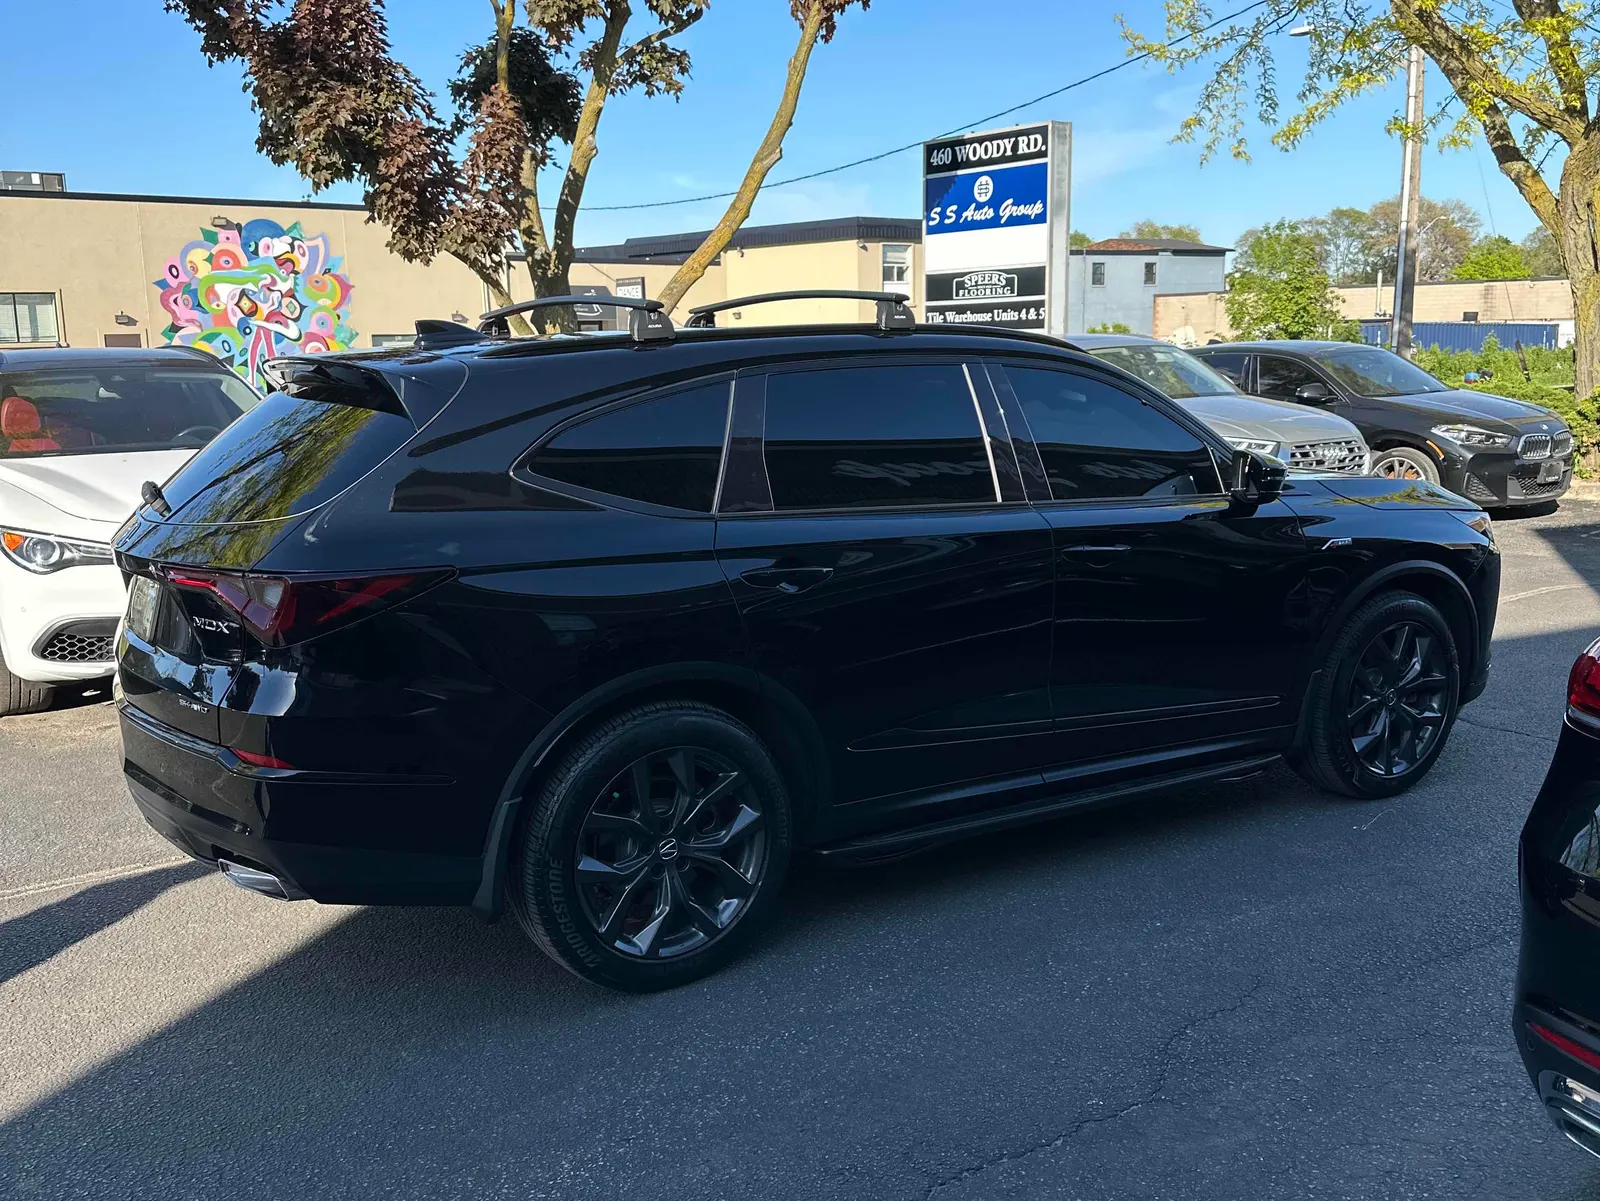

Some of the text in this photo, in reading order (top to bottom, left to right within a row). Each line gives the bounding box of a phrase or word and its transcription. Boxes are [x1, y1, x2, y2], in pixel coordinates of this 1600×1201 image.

[930, 133, 1046, 166] 460 WOODY RD.
[928, 198, 1044, 226] S S Auto Group
[964, 273, 1007, 288] SPEERS
[959, 286, 1011, 297] FLOORING
[927, 307, 1045, 323] Tile Warehouse Units 4 & 5
[192, 615, 231, 635] MDX
[548, 858, 601, 967] BRIDGESTONE
